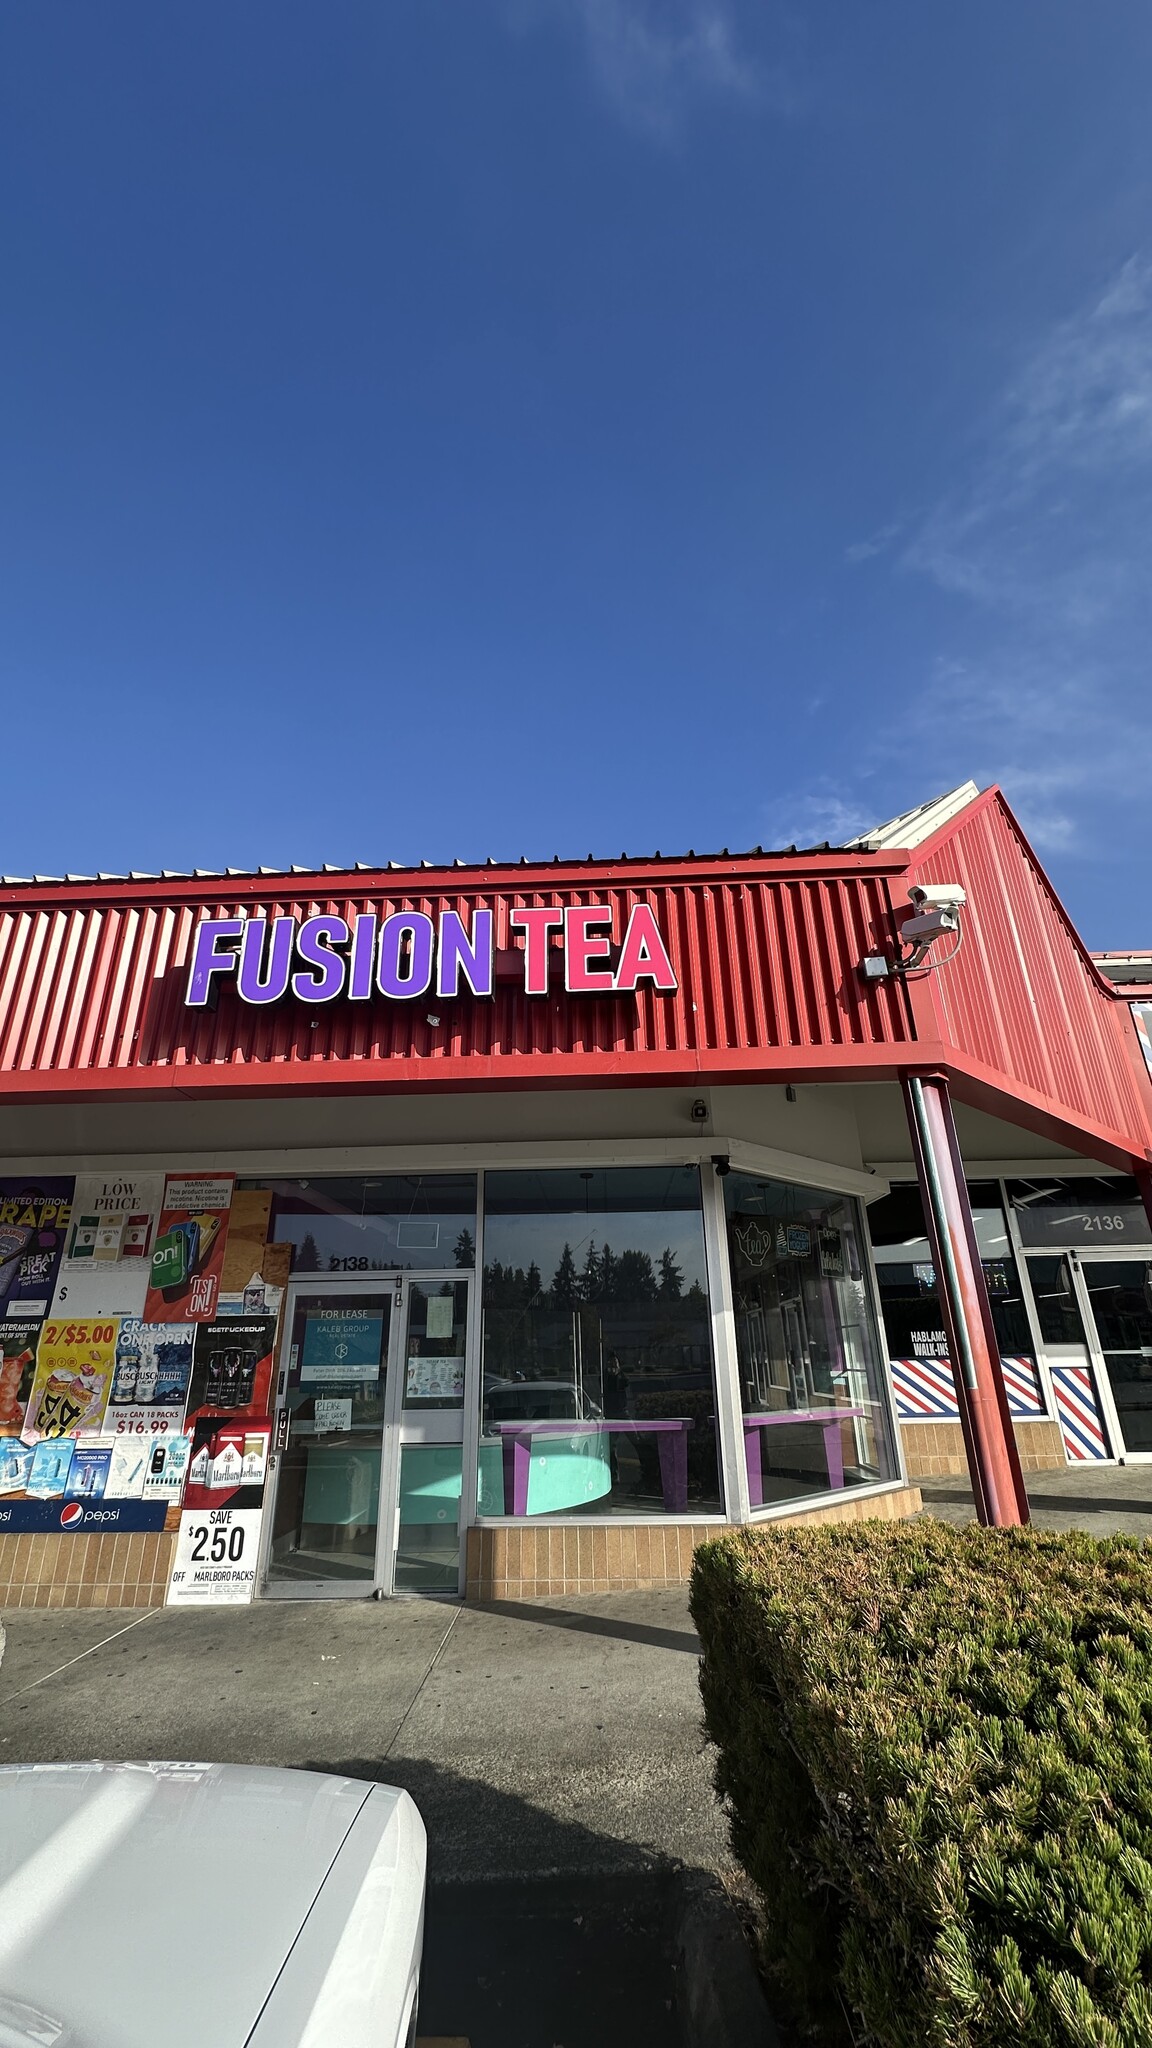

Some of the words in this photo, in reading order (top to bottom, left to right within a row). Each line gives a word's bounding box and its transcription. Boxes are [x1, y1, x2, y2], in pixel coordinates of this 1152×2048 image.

[186, 909, 493, 1006] FUSION
[510, 903, 679, 995] TEA
[102, 1183, 136, 1196] LOW
[0, 1197, 32, 1206] LIMITED
[33, 1197, 68, 1206] EDITION
[94, 1197, 141, 1210] PRICE
[0, 1204, 73, 1229] RAPE
[1082, 1215, 1125, 1231] 2136
[788, 1230, 809, 1240] FROZEN
[744, 1233, 765, 1256] tea
[21, 1252, 57, 1266] GREAT
[152, 1245, 178, 1265] on!
[20, 1262, 48, 1276] PICK
[330, 1256, 369, 1272] 2138
[59, 1286, 68, 1301] $
[320, 1310, 339, 1319] FOR
[341, 1309, 368, 1319] LEASE
[123, 1320, 167, 1332] CRACK
[317, 1325, 341, 1333] KALEB
[44, 1324, 114, 1346] 2/$5.00
[155, 1332, 193, 1345] OPEN
[911, 1331, 948, 1342] HABLAMO
[117, 1372, 136, 1381] BUSC
[316, 1401, 341, 1411] PLEASE
[116, 1420, 169, 1434] $16.99
[277, 1412, 286, 1447] PULL
[191, 1464, 206, 1478] Marlb
[213, 1464, 240, 1482] Marlboro
[83, 1509, 120, 1523] pepsi
[209, 1511, 233, 1524] SAVE
[188, 1526, 245, 1562] $2.50
[173, 1571, 186, 1582] OFF
[193, 1571, 231, 1582] MARLBORO
[231, 1570, 255, 1581] PACKS
